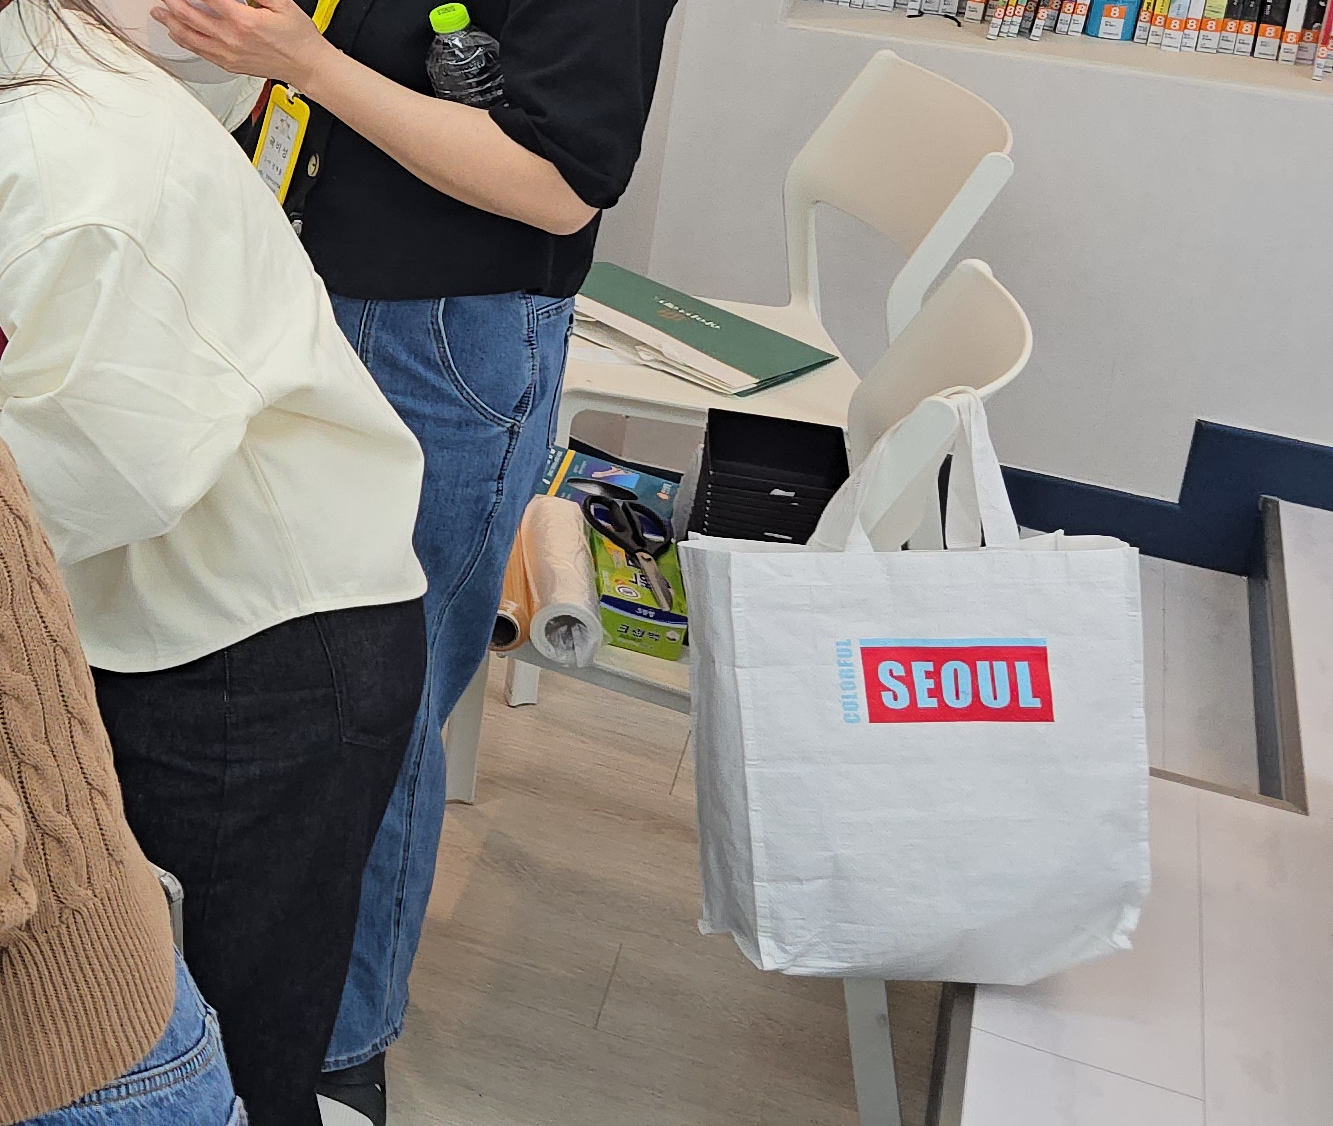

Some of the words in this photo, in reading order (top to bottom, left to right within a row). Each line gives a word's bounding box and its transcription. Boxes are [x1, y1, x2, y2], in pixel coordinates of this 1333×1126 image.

[1006, 6, 1015, 16] 8
[1015, 6, 1025, 16] 8
[1064, 2, 1075, 13] 8
[1078, 4, 1086, 15] 8
[1110, 6, 1120, 17] 8
[995, 8, 1004, 18] 8
[1038, 9, 1047, 19] 8
[1140, 11, 1149, 21] 8
[1155, 16, 1165, 26] 8
[1171, 20, 1179, 30] 8
[1187, 19, 1196, 29] 8
[1207, 21, 1216, 30] 8
[1227, 21, 1236, 31] 8
[1242, 22, 1251, 33] 8
[1265, 26, 1275, 37] 8
[1287, 33, 1296, 43] 8
[1318, 48, 1327, 58] 8
[835, 638, 861, 724] COLORFUL
[877, 660, 1042, 710] SEOUL
